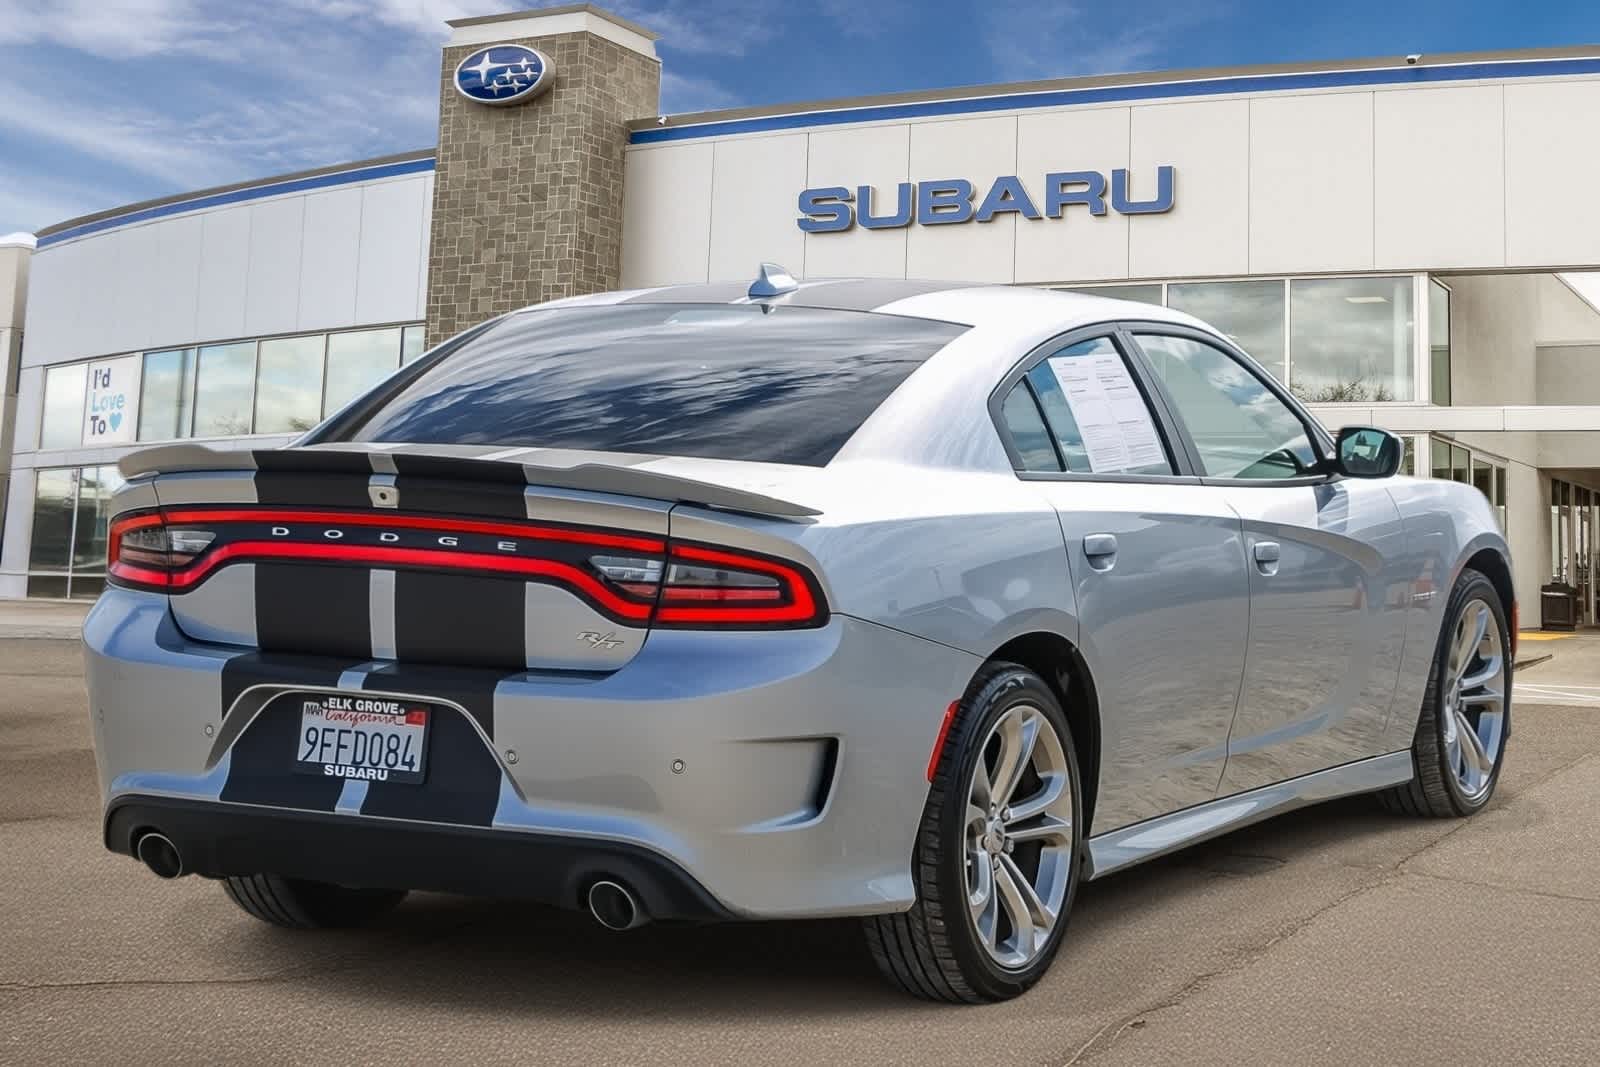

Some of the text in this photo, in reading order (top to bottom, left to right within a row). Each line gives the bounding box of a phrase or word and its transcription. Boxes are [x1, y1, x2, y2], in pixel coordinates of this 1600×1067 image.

[796, 165, 1176, 234] SUBARU
[94, 368, 111, 390] I'd
[91, 392, 125, 412] Love
[91, 416, 106, 435] To
[271, 526, 517, 552] DODGE
[329, 697, 399, 714] ELK GROVE
[325, 710, 405, 728] California
[303, 727, 416, 770] 9FFD084
[324, 764, 388, 781] SUBARU
